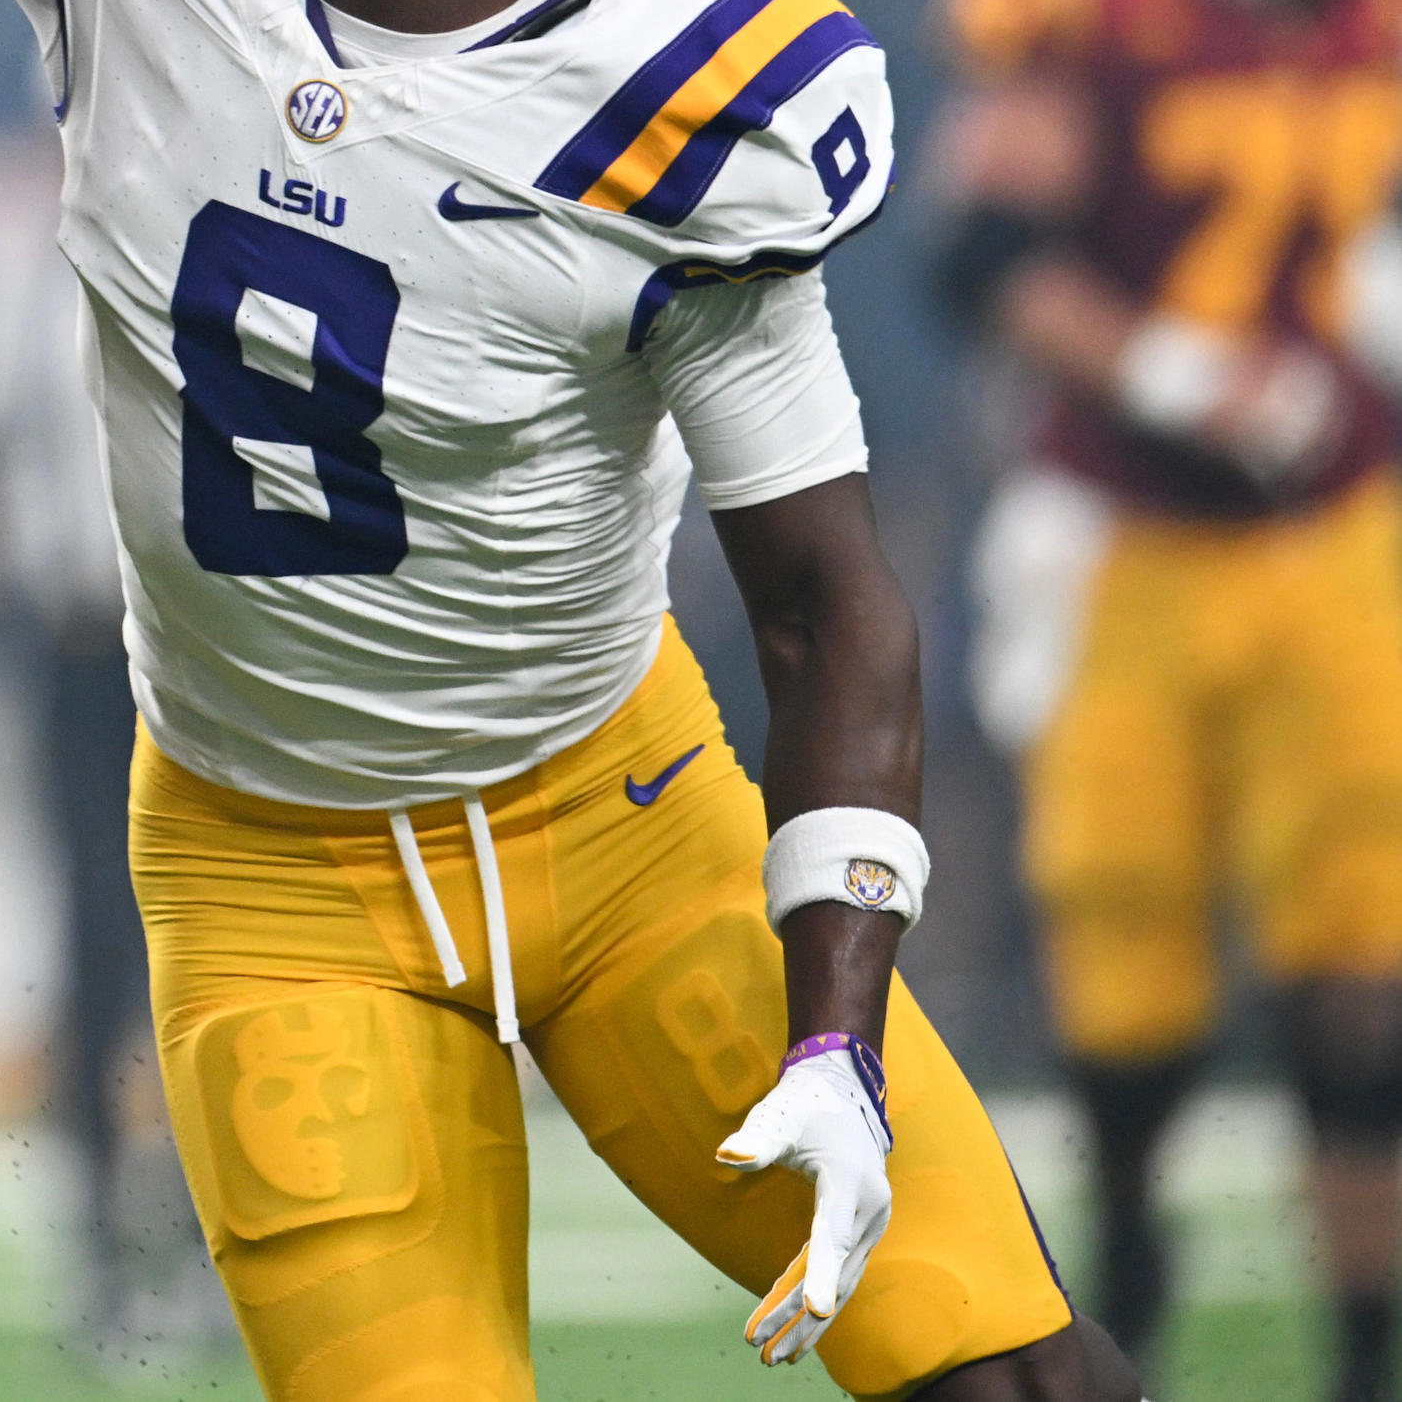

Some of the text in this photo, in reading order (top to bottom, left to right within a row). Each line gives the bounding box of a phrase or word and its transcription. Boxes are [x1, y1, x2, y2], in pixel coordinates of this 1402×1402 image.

[291, 82, 345, 138] SEC
[259, 168, 346, 227] LSU
[170, 199, 408, 577] 8
